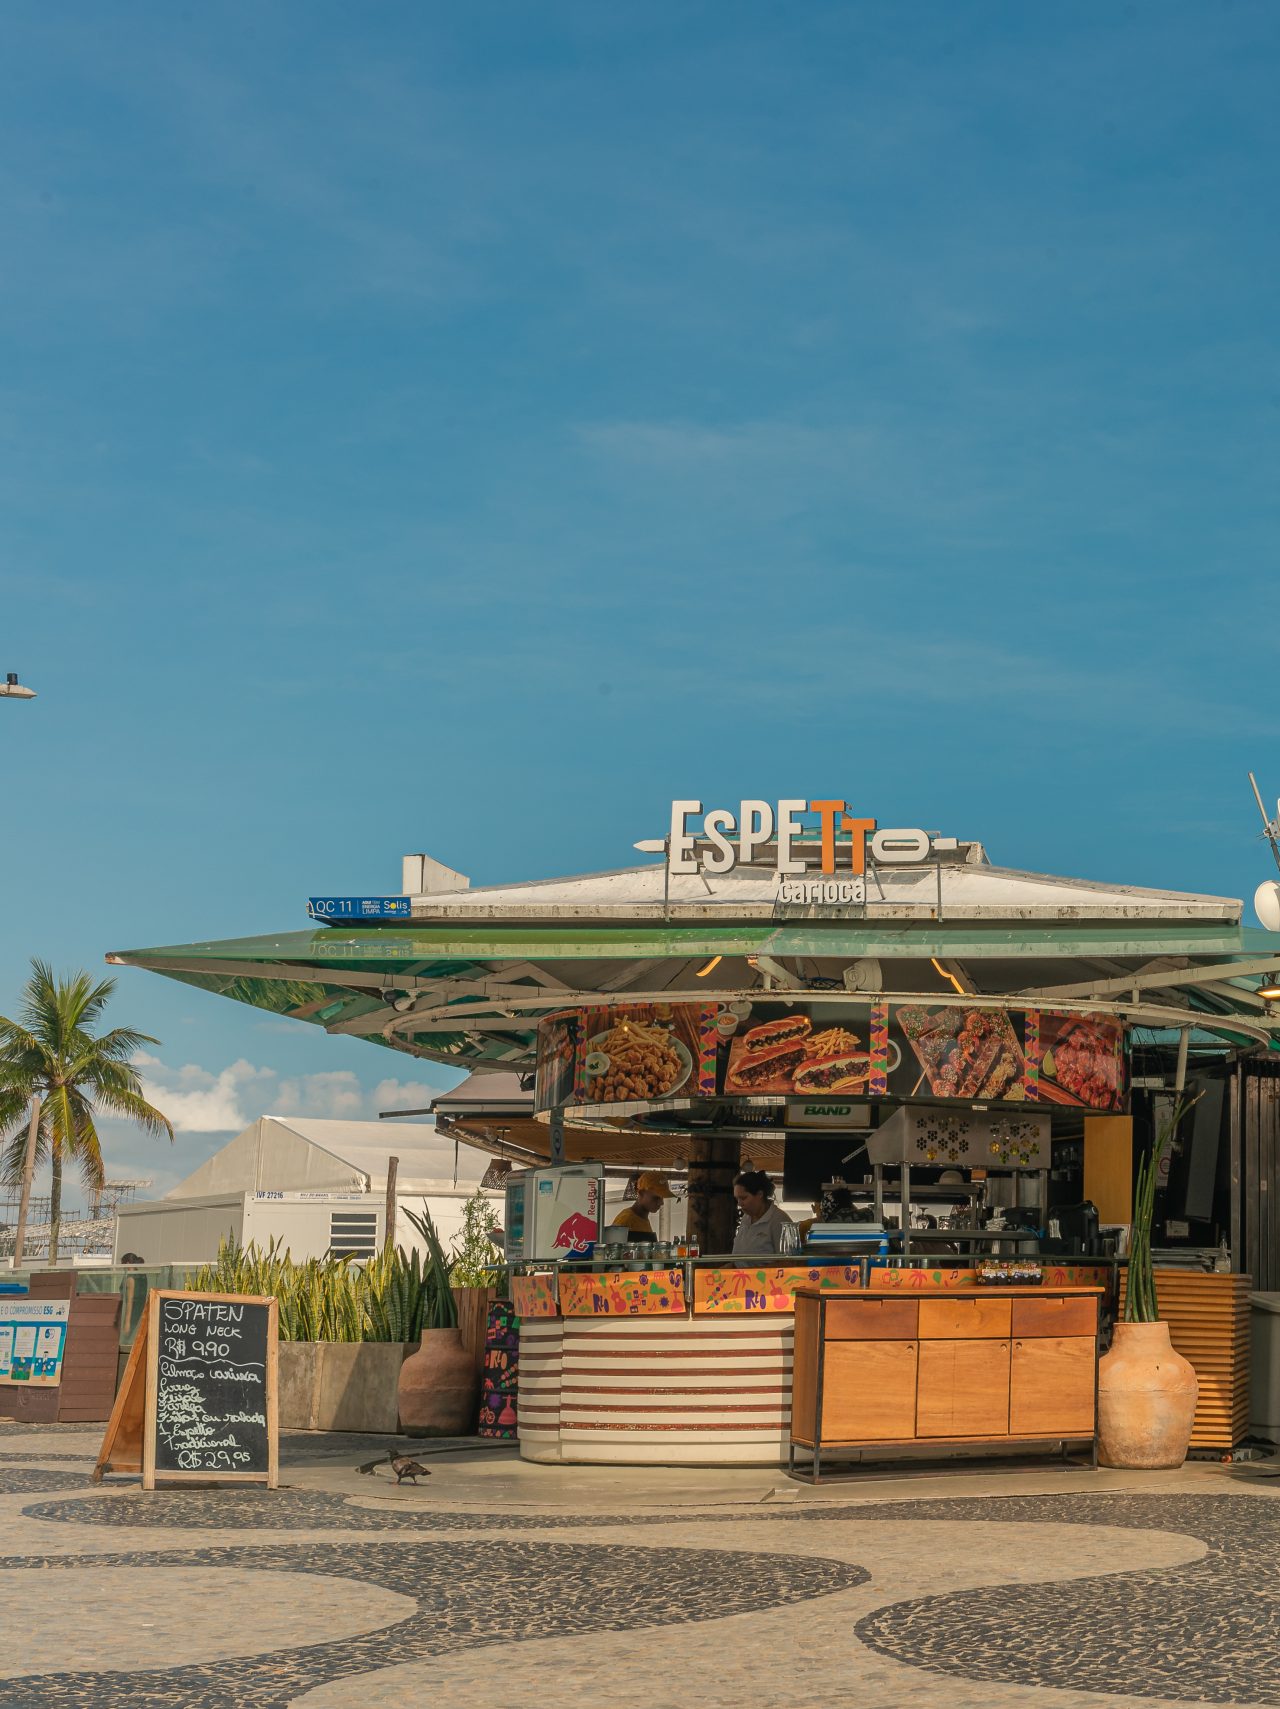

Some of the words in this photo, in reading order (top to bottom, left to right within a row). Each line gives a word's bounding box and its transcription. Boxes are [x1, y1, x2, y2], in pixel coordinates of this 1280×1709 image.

[670, 799, 930, 875] ESPETTO
[778, 881, 867, 904] carioca
[316, 900, 335, 913] QC
[339, 901, 352, 912] 11
[383, 900, 408, 910] Solis
[804, 1105, 851, 1116] BAND
[164, 1300, 244, 1322] SPATEN
[164, 1322, 197, 1335] LONG
[206, 1325, 243, 1339] NECK
[164, 1337, 186, 1360] R$
[192, 1340, 230, 1357] 9.90
[177, 1450, 202, 1469] R$
